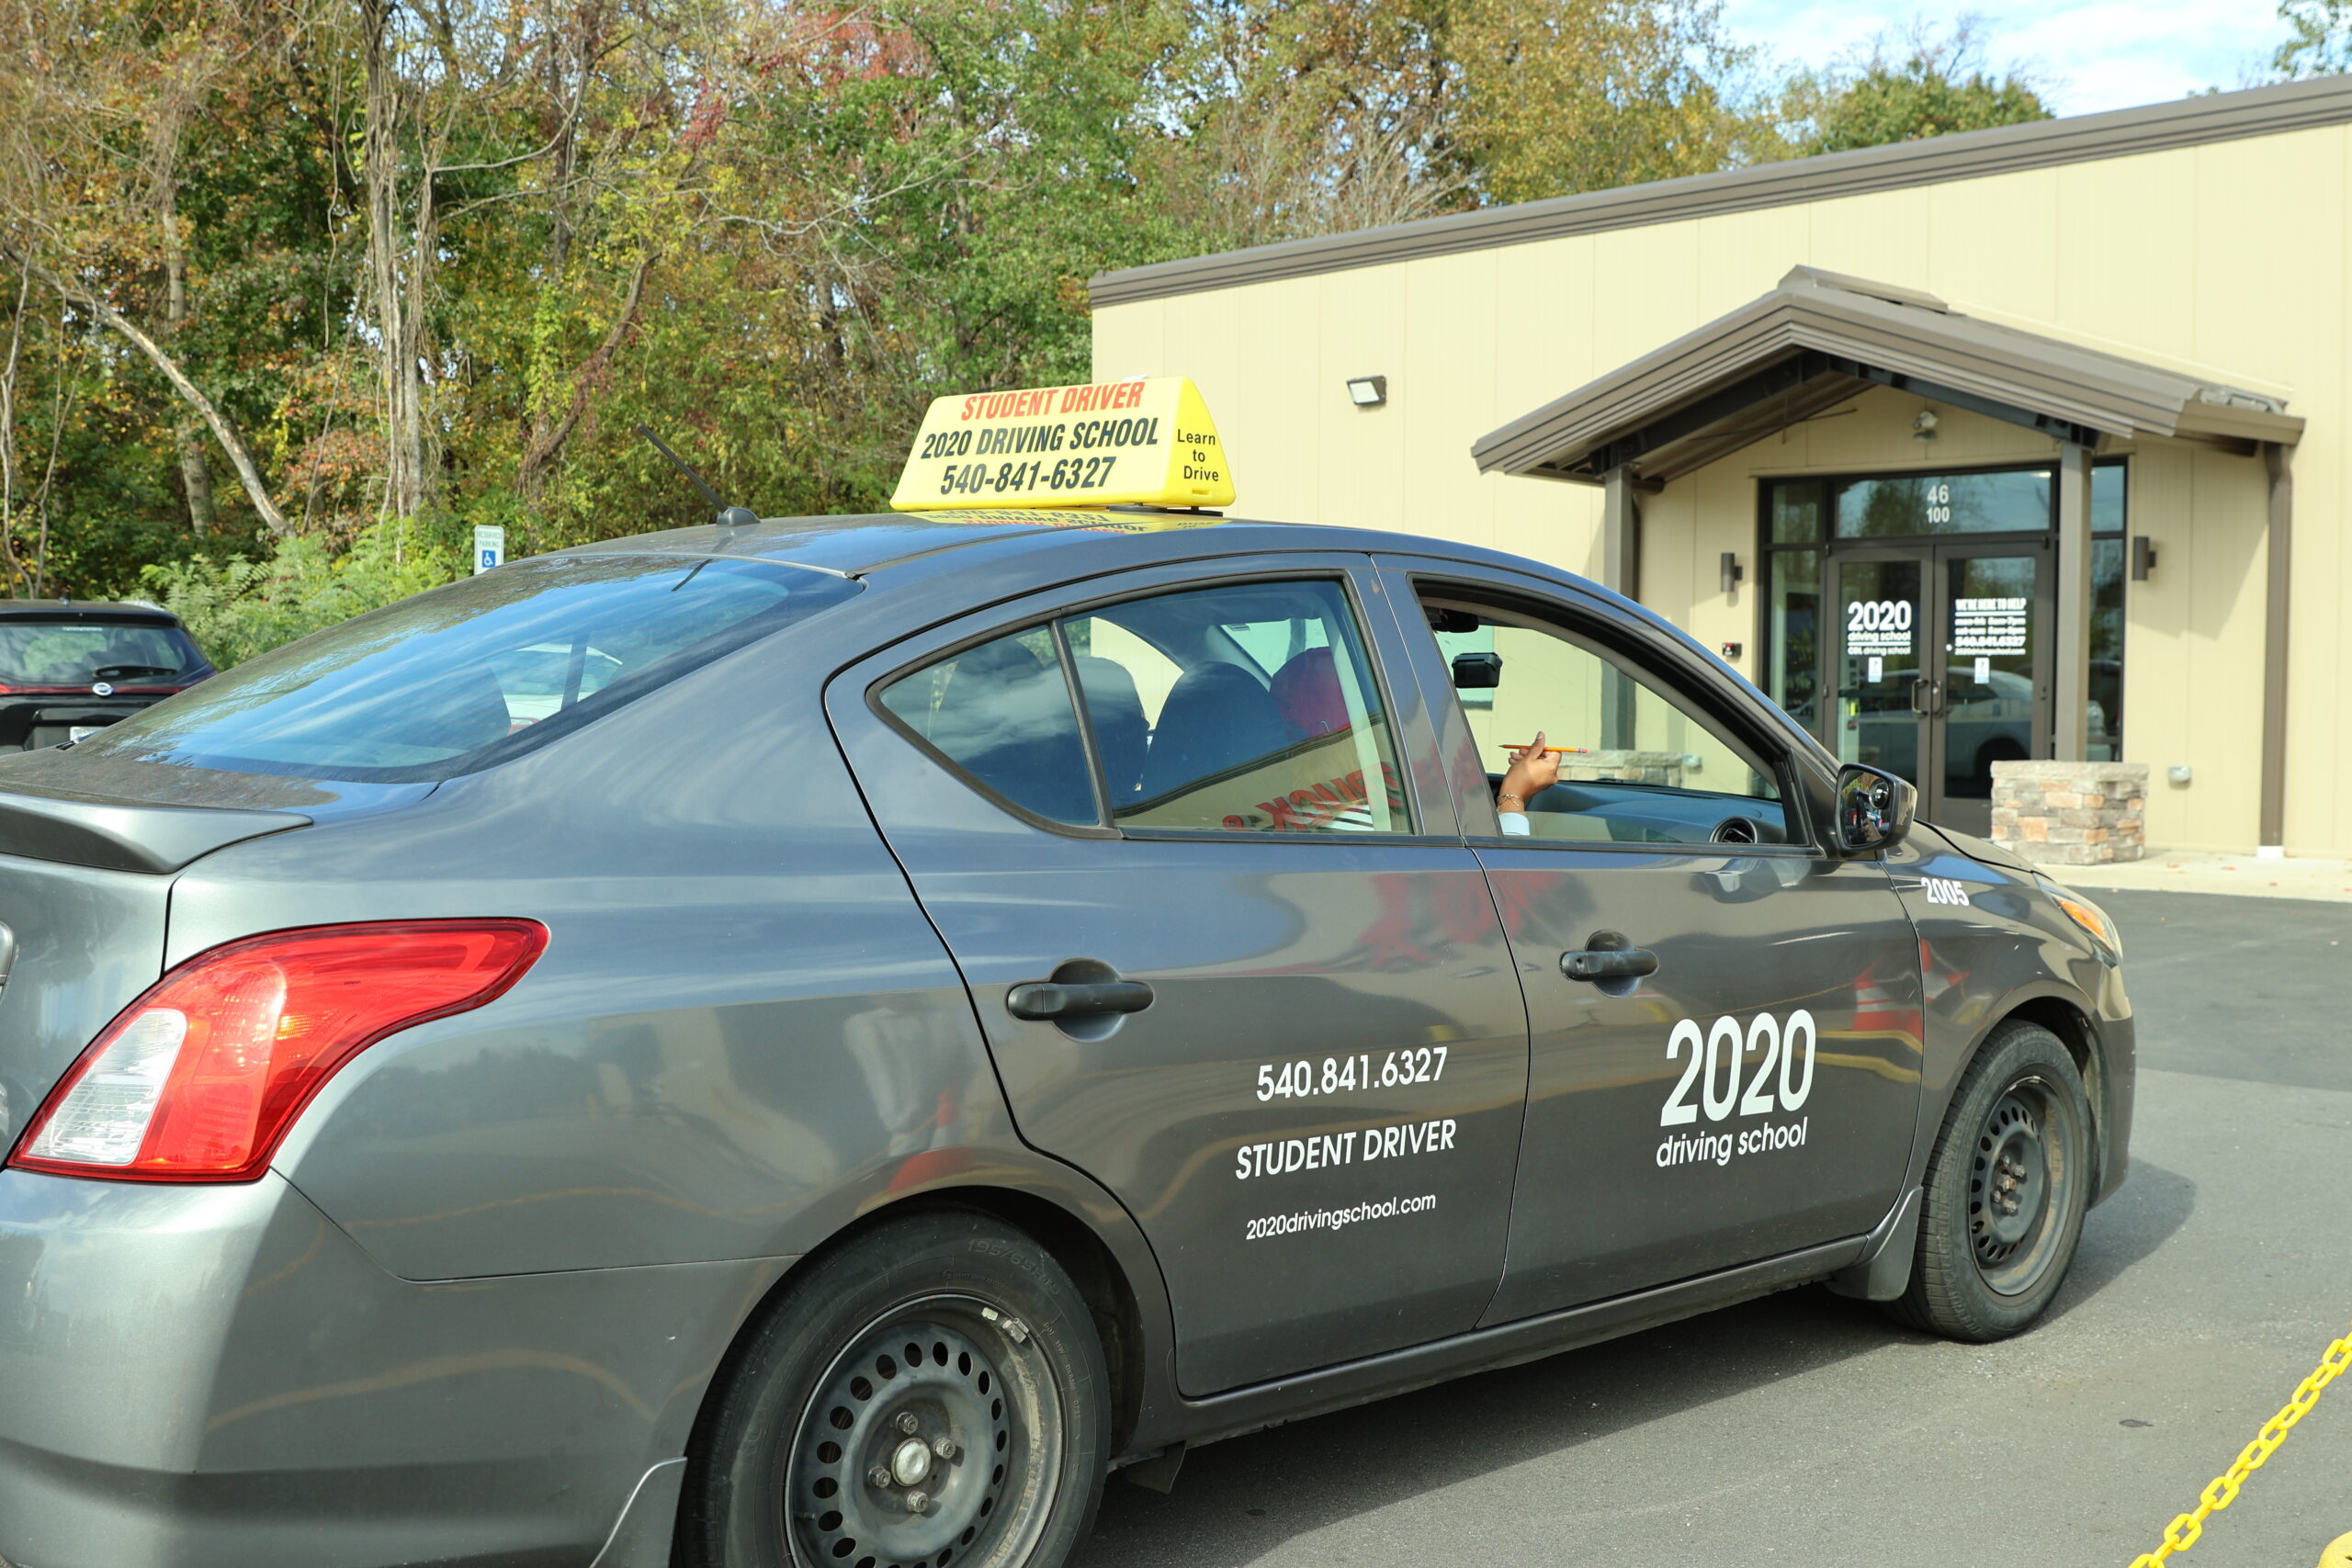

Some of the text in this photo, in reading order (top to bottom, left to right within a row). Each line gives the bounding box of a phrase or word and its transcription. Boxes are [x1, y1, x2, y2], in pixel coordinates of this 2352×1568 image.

[961, 381, 1146, 421] STUDENT DRIVER
[921, 418, 1159, 460] 2020 DRIVING SCHOOL
[1177, 429, 1216, 447] Learn
[1183, 465, 1220, 482] Drive
[1193, 449, 1206, 463] to
[940, 457, 1117, 496] 540-841-6327
[1927, 484, 1950, 504] 46
[1926, 506, 1951, 524] 100
[1848, 600, 1912, 631] 2020
[1848, 630, 1912, 643] driving school
[1921, 877, 1970, 907] 2005
[1256, 1045, 1448, 1102] 540.841.6327
[1660, 1009, 1816, 1127] 2020
[1235, 1118, 1457, 1181] STUDENT DRIVER
[1656, 1116, 1809, 1168] driving school
[1245, 1194, 1437, 1241] 2020drivingschool.com
